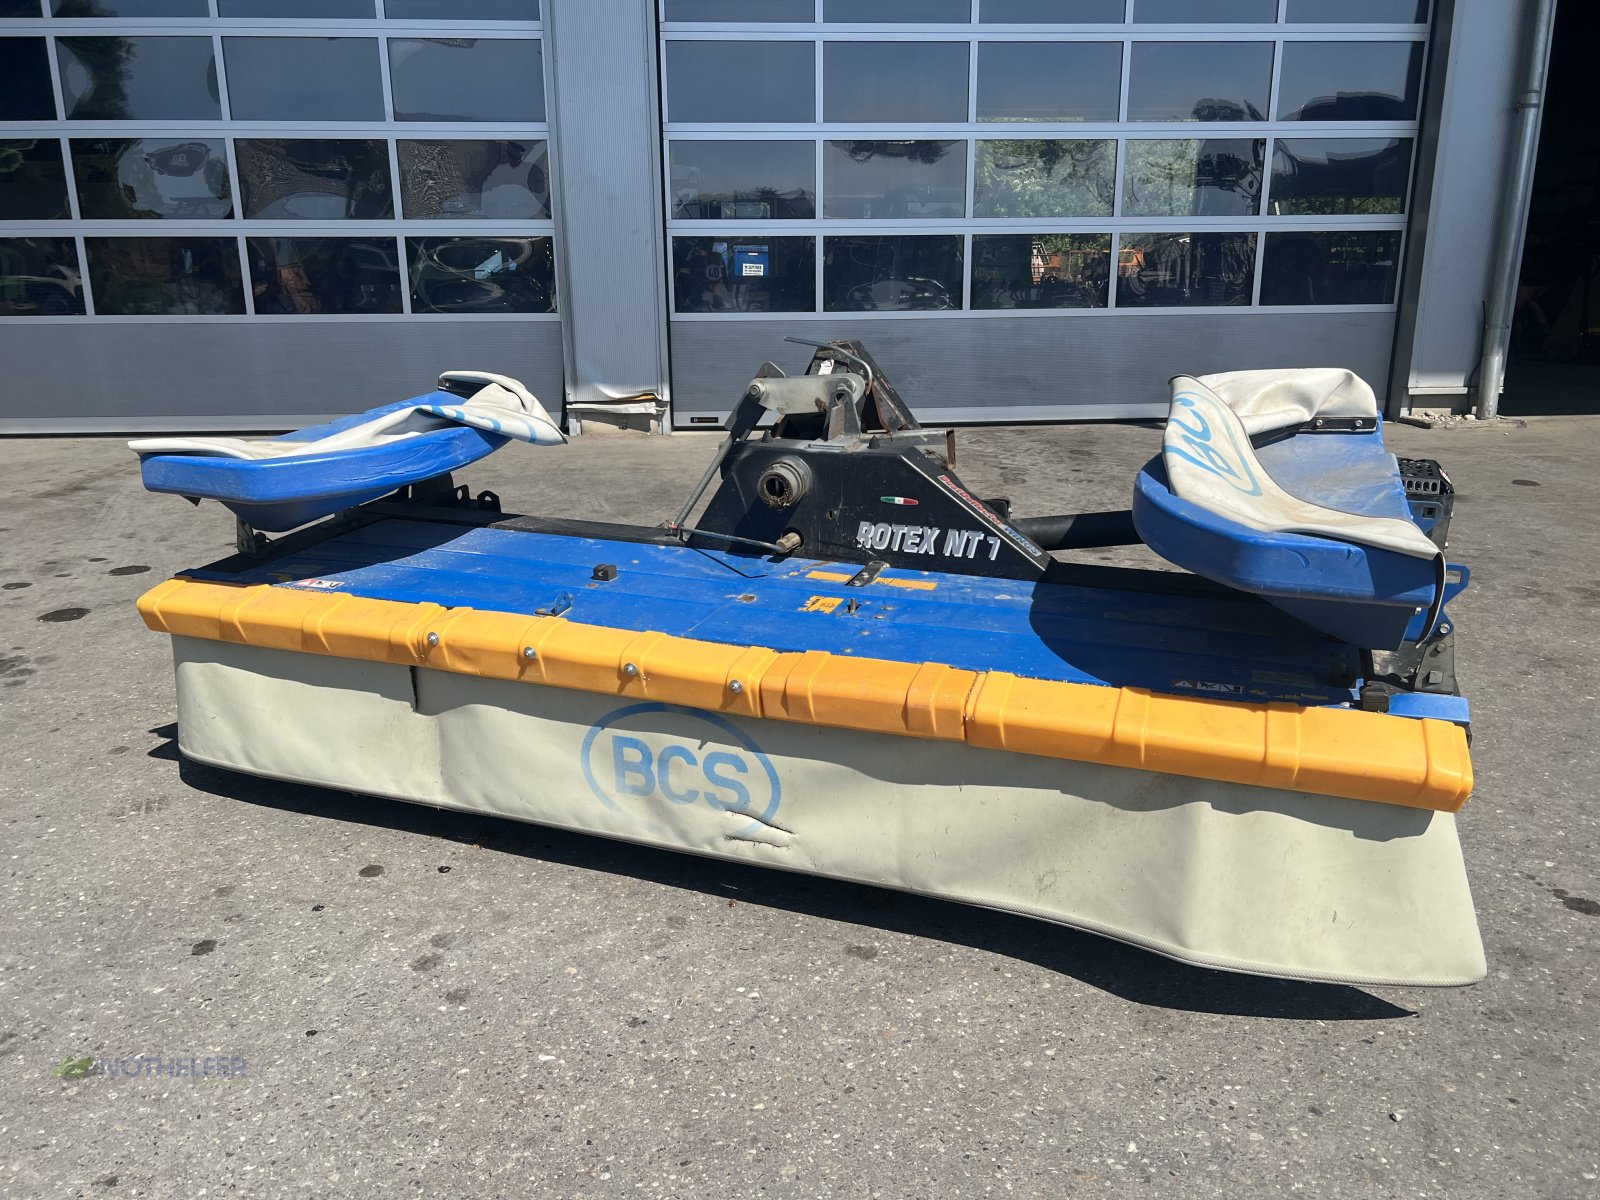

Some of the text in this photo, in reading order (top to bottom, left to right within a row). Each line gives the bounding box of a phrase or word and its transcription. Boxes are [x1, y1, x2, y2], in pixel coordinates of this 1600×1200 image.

[856, 521, 941, 555] ROTEX
[943, 529, 985, 558] NT
[612, 734, 751, 811] BCS
